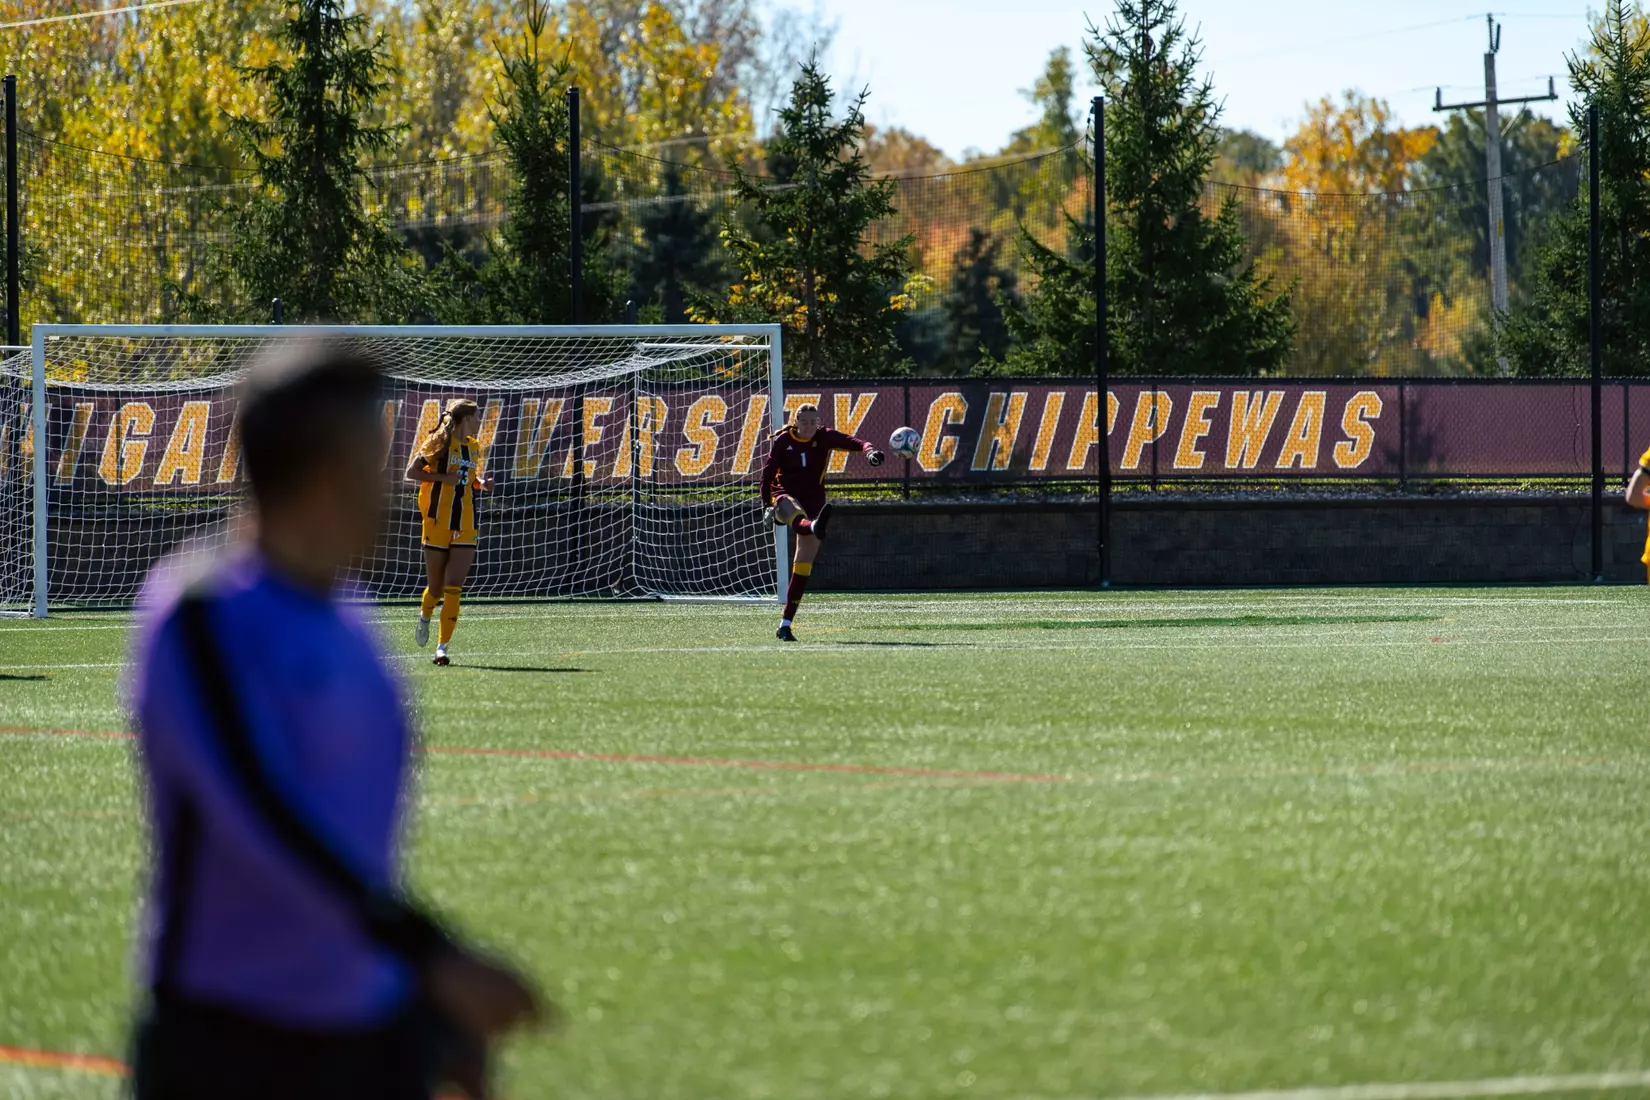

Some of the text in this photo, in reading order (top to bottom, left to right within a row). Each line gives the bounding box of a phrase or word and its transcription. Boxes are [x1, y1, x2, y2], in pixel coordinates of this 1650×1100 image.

[382, 392, 878, 482] IVERSITY
[915, 389, 1384, 473] CHIPPEWAS
[800, 452, 807, 468] 1
